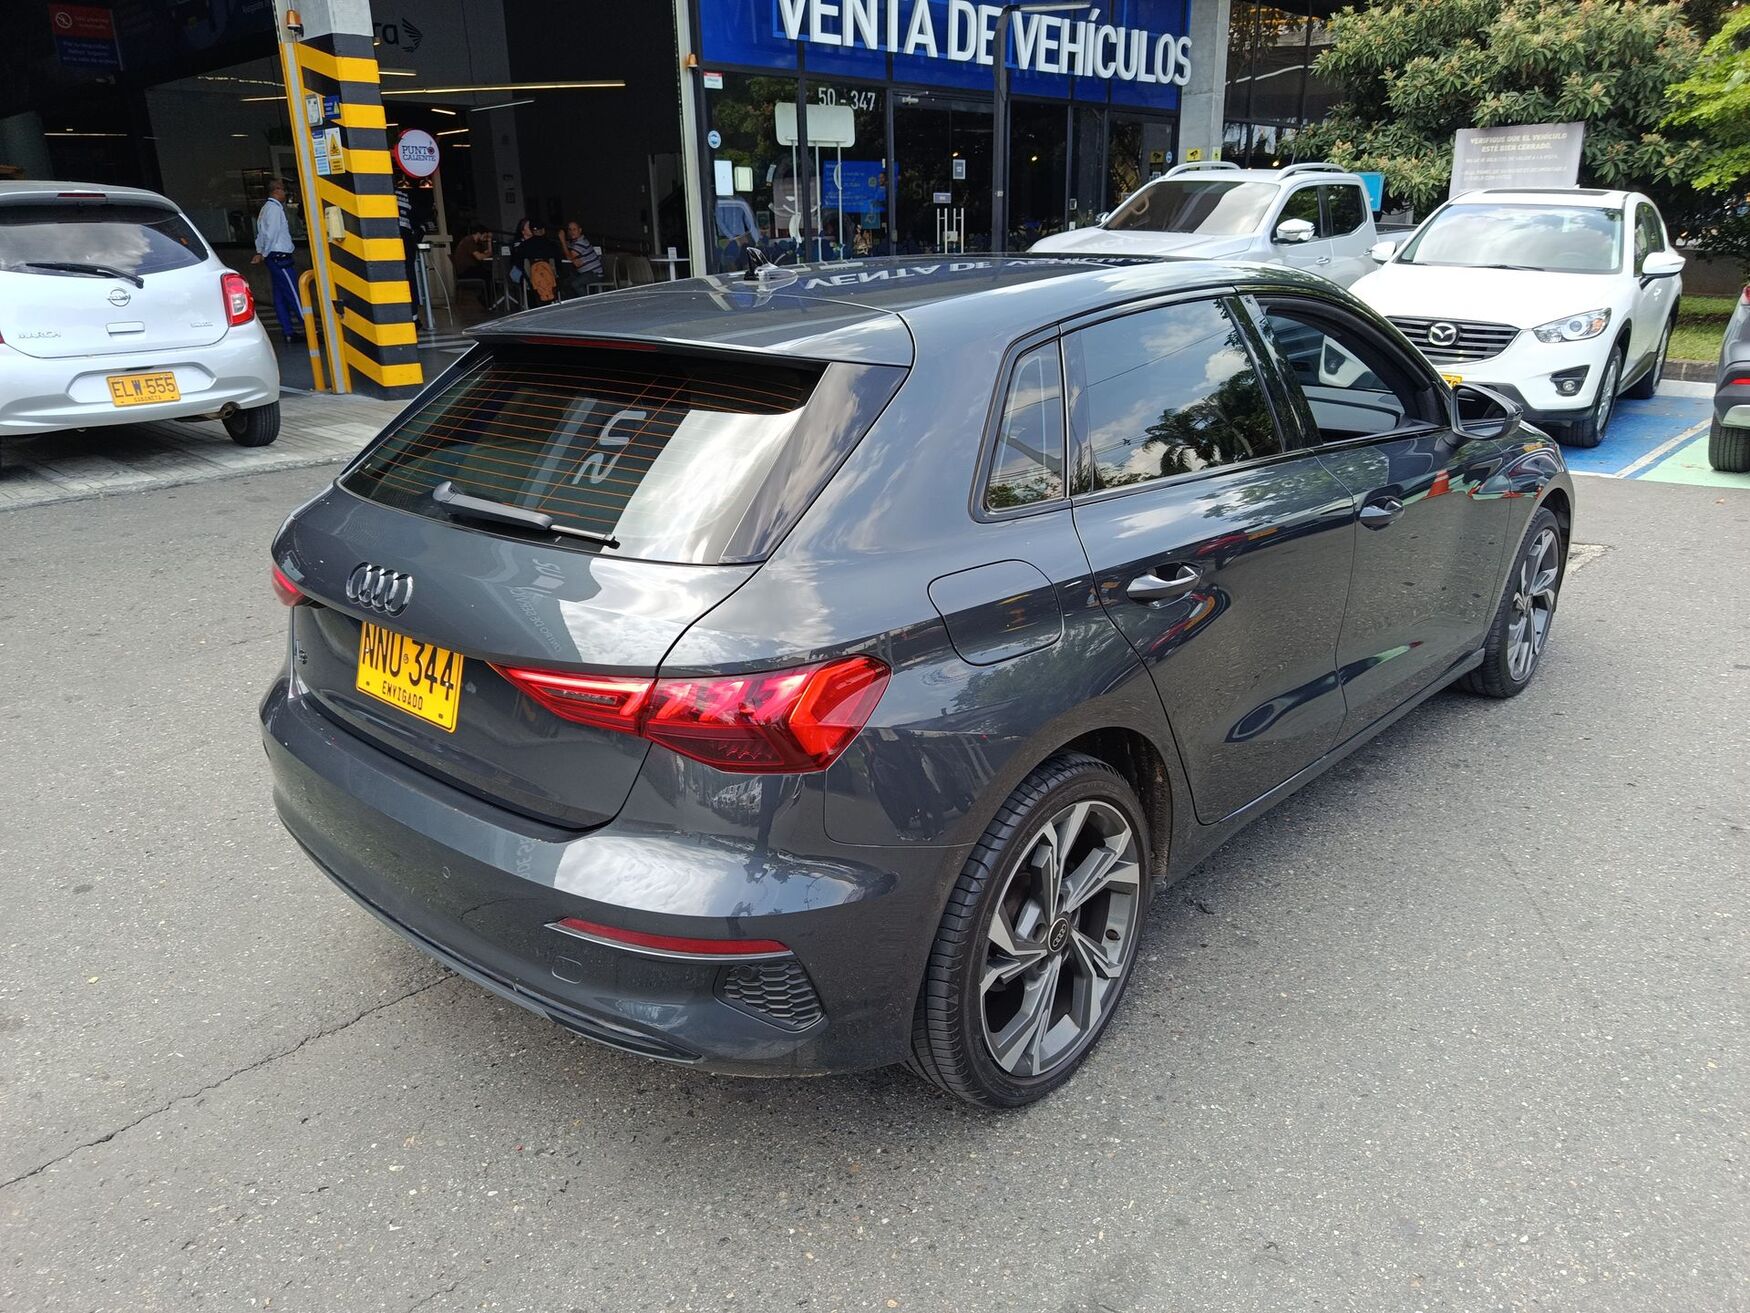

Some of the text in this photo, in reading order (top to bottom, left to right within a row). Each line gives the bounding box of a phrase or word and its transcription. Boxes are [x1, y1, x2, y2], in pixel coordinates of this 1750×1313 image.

[948, 0, 995, 65] DE
[1012, 8, 1192, 86] VEHÍCULOS
[818, 87, 836, 107] 50
[850, 90, 876, 111] 347
[401, 145, 435, 155] PUNTO
[402, 154, 437, 162] CALIENTE
[111, 376, 176, 398] ELW 555
[408, 639, 455, 701] 344
[382, 680, 424, 711] ENVIGADO
